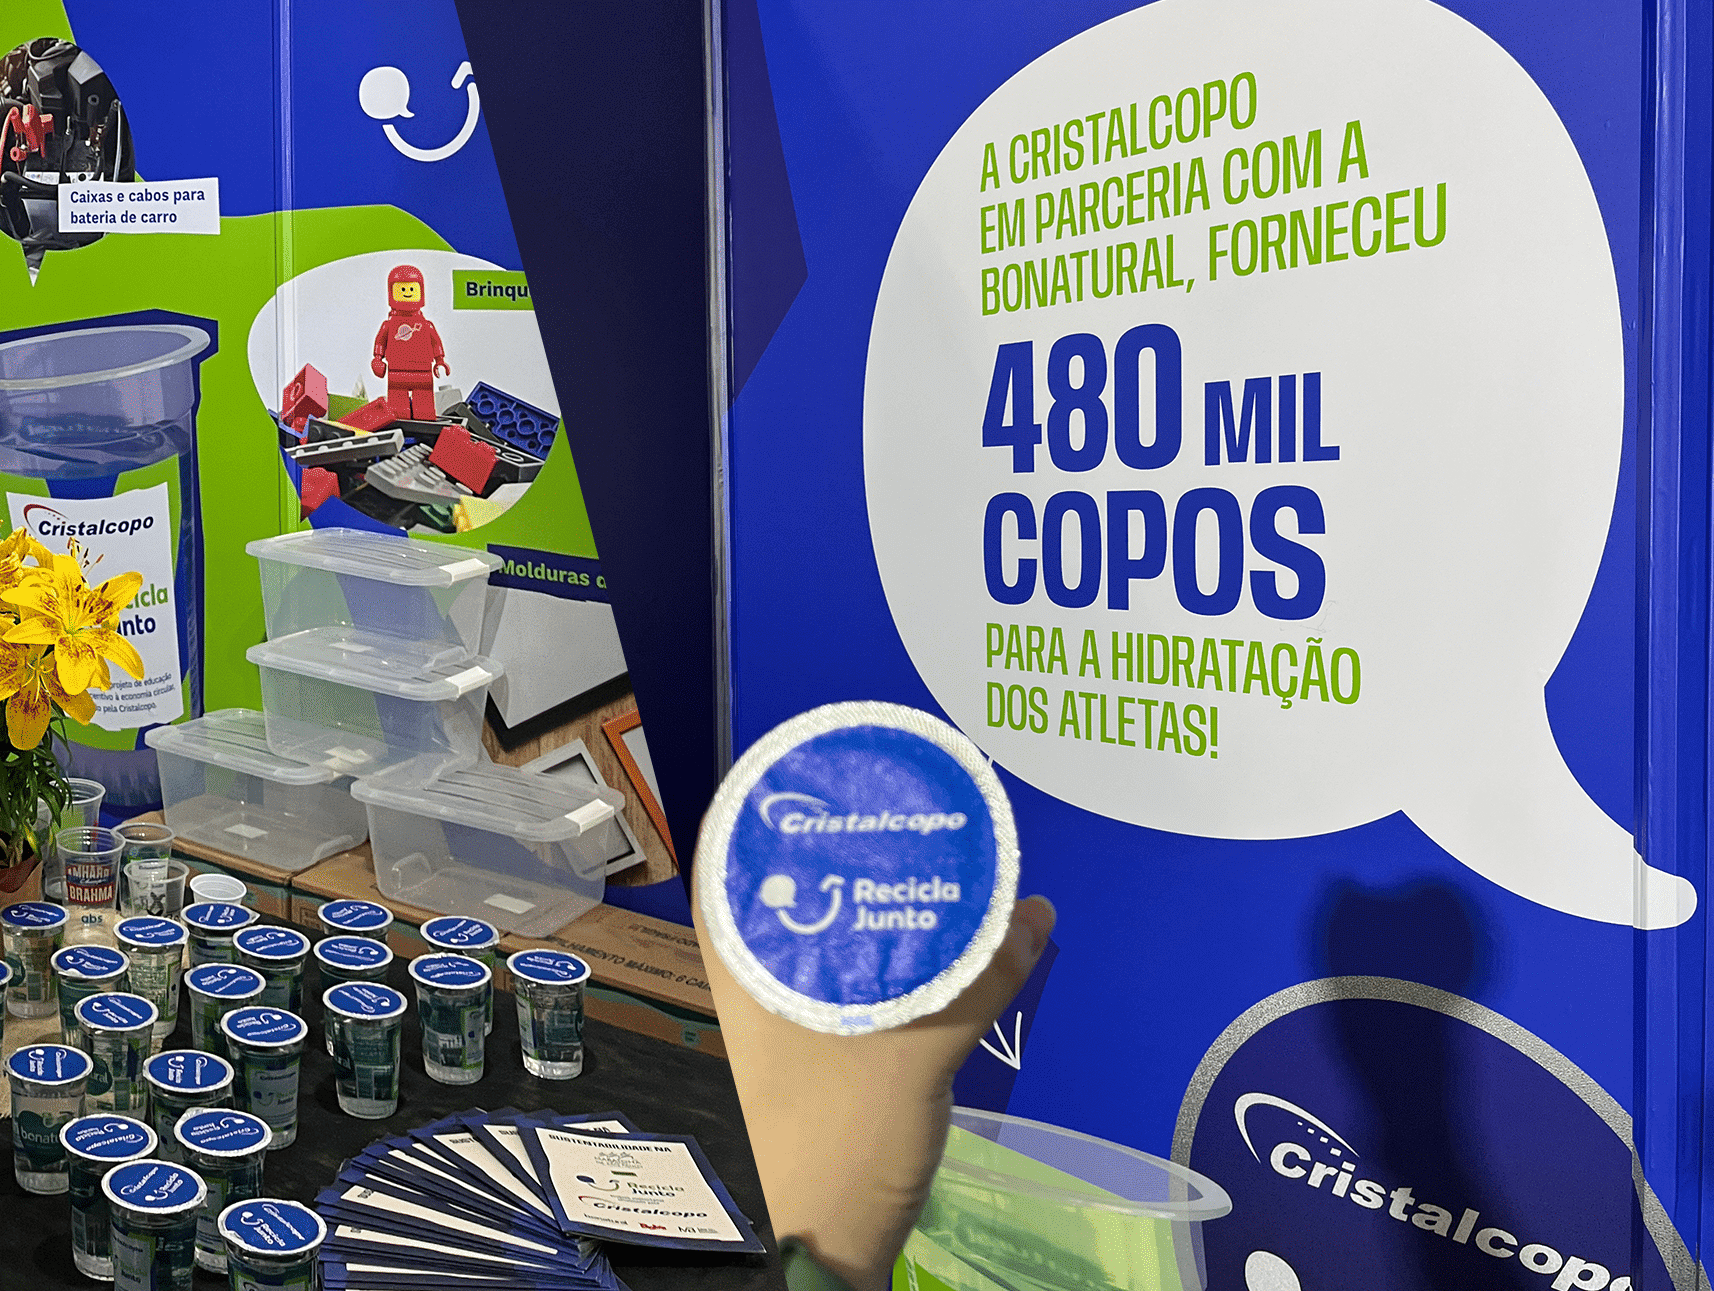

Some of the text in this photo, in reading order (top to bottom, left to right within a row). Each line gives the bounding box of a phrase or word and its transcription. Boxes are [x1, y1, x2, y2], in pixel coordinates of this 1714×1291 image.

[980, 71, 1256, 192] A CRISTALCOPO
[70, 189, 205, 205] Caixas e cabos para
[980, 120, 1369, 254] EM PARCERIA COM A
[70, 210, 177, 224] bateria de carro
[982, 182, 1447, 316] BONATURAL, FORNECEU
[982, 323, 1340, 473] 480 MIL
[38, 515, 154, 537] Cristalcopo
[983, 485, 1326, 620] COPOS
[986, 622, 1361, 709] PARA A HIDRATAÇÃO
[986, 682, 1219, 760] DOS ATLETAS!
[780, 810, 967, 835] Cristalcopo
[70, 885, 113, 902] BRAHMA
[853, 877, 961, 903] Recicla
[853, 909, 938, 931] Junto
[594, 1203, 707, 1218] Cristalcopo
